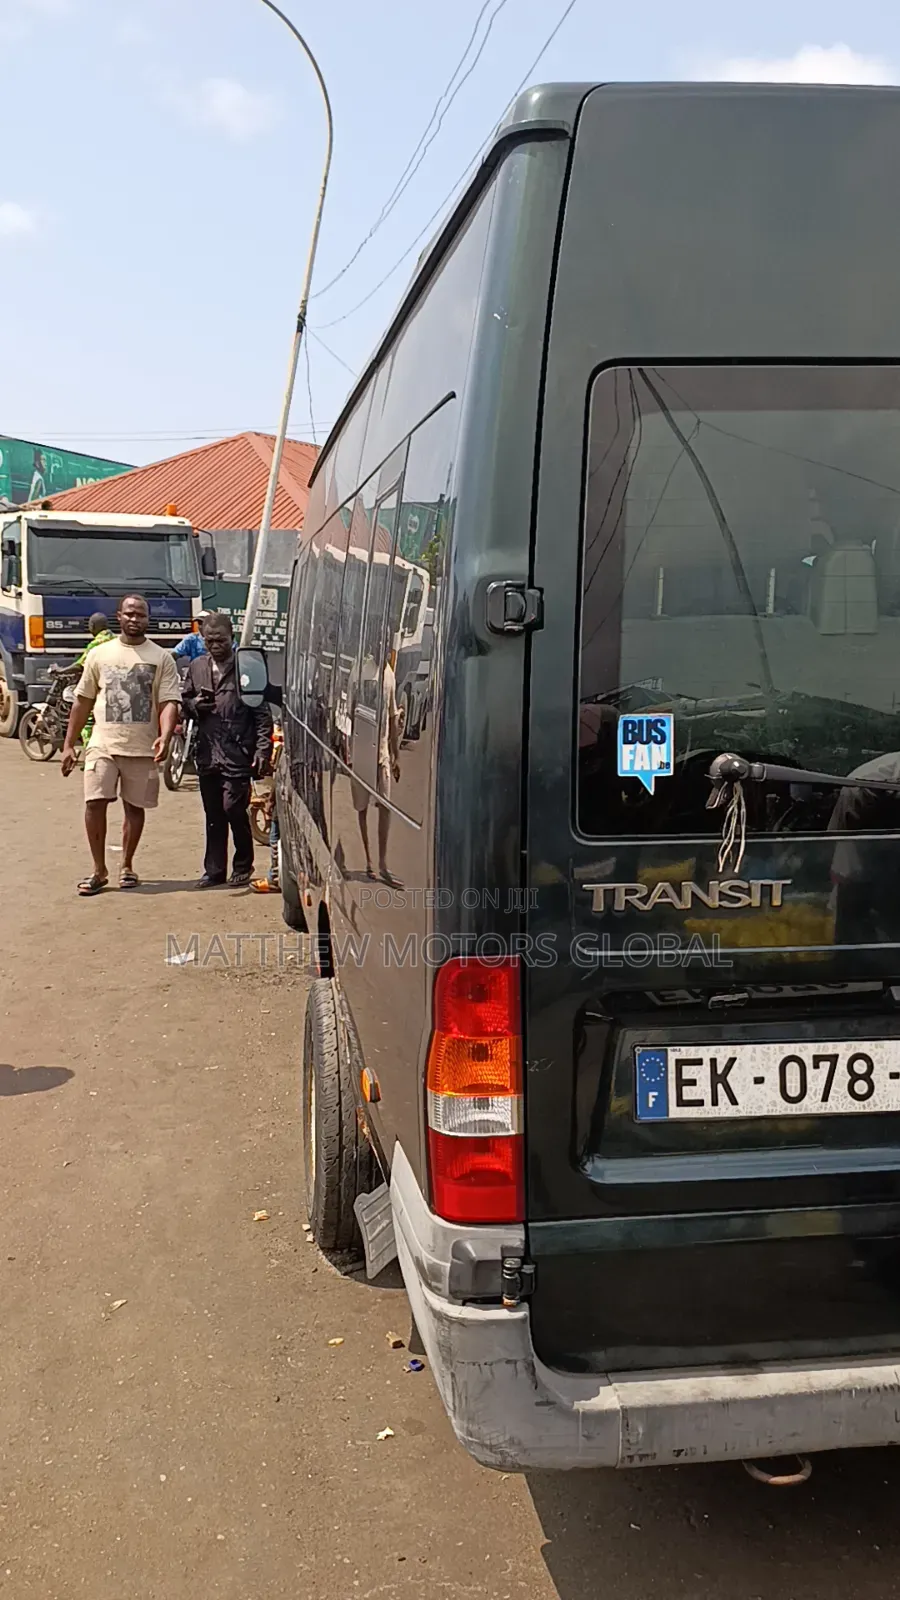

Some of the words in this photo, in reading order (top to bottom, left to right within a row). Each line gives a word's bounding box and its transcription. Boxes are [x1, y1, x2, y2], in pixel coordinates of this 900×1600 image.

[46, 620, 64, 629] 85
[158, 621, 192, 630] DAF
[623, 718, 667, 745] BUS
[582, 878, 793, 912] TRANSIT
[647, 1091, 659, 1108] F
